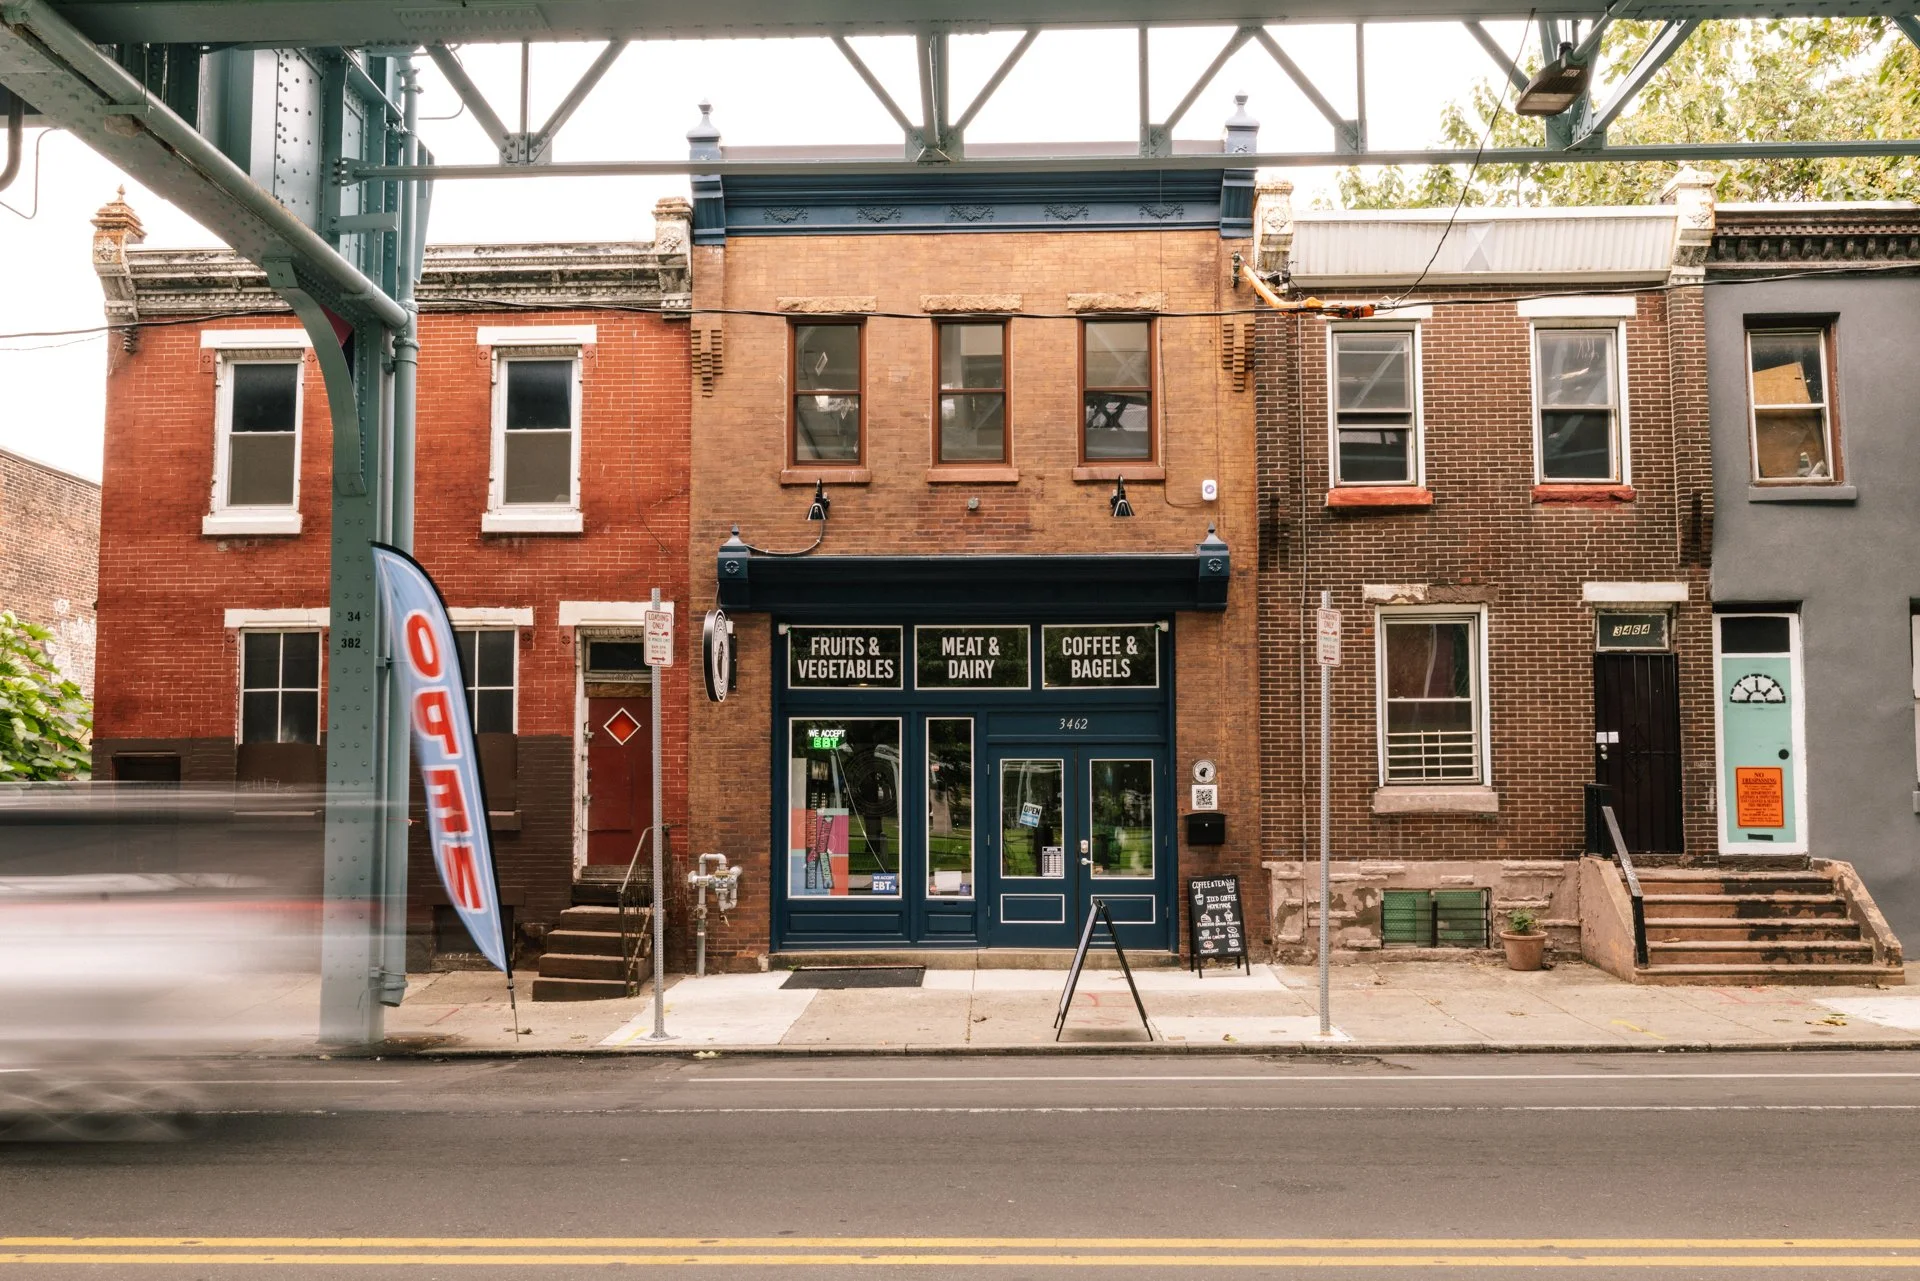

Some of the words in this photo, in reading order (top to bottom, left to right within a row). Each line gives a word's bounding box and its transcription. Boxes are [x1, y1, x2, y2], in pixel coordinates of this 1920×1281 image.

[347, 611, 361, 622] 34
[648, 614, 669, 622] LOADING
[1613, 624, 1650, 636] 3464
[341, 637, 361, 648] 382
[810, 636, 865, 657] FRUITS
[868, 636, 881, 657] &
[941, 636, 984, 657] MEAT
[988, 636, 1001, 657] &
[1061, 635, 1122, 657] COFFEE
[1125, 635, 1139, 656] &
[797, 659, 895, 680] VEGETABLES
[948, 659, 995, 680] DAIRY
[1070, 658, 1132, 679] BAGELS
[1058, 718, 1088, 731] 3462
[808, 729, 820, 737] WE
[821, 729, 846, 738] ACCEPT
[813, 737, 839, 749] EBT
[1023, 804, 1041, 816] OPEN
[872, 881, 892, 891] EBT
